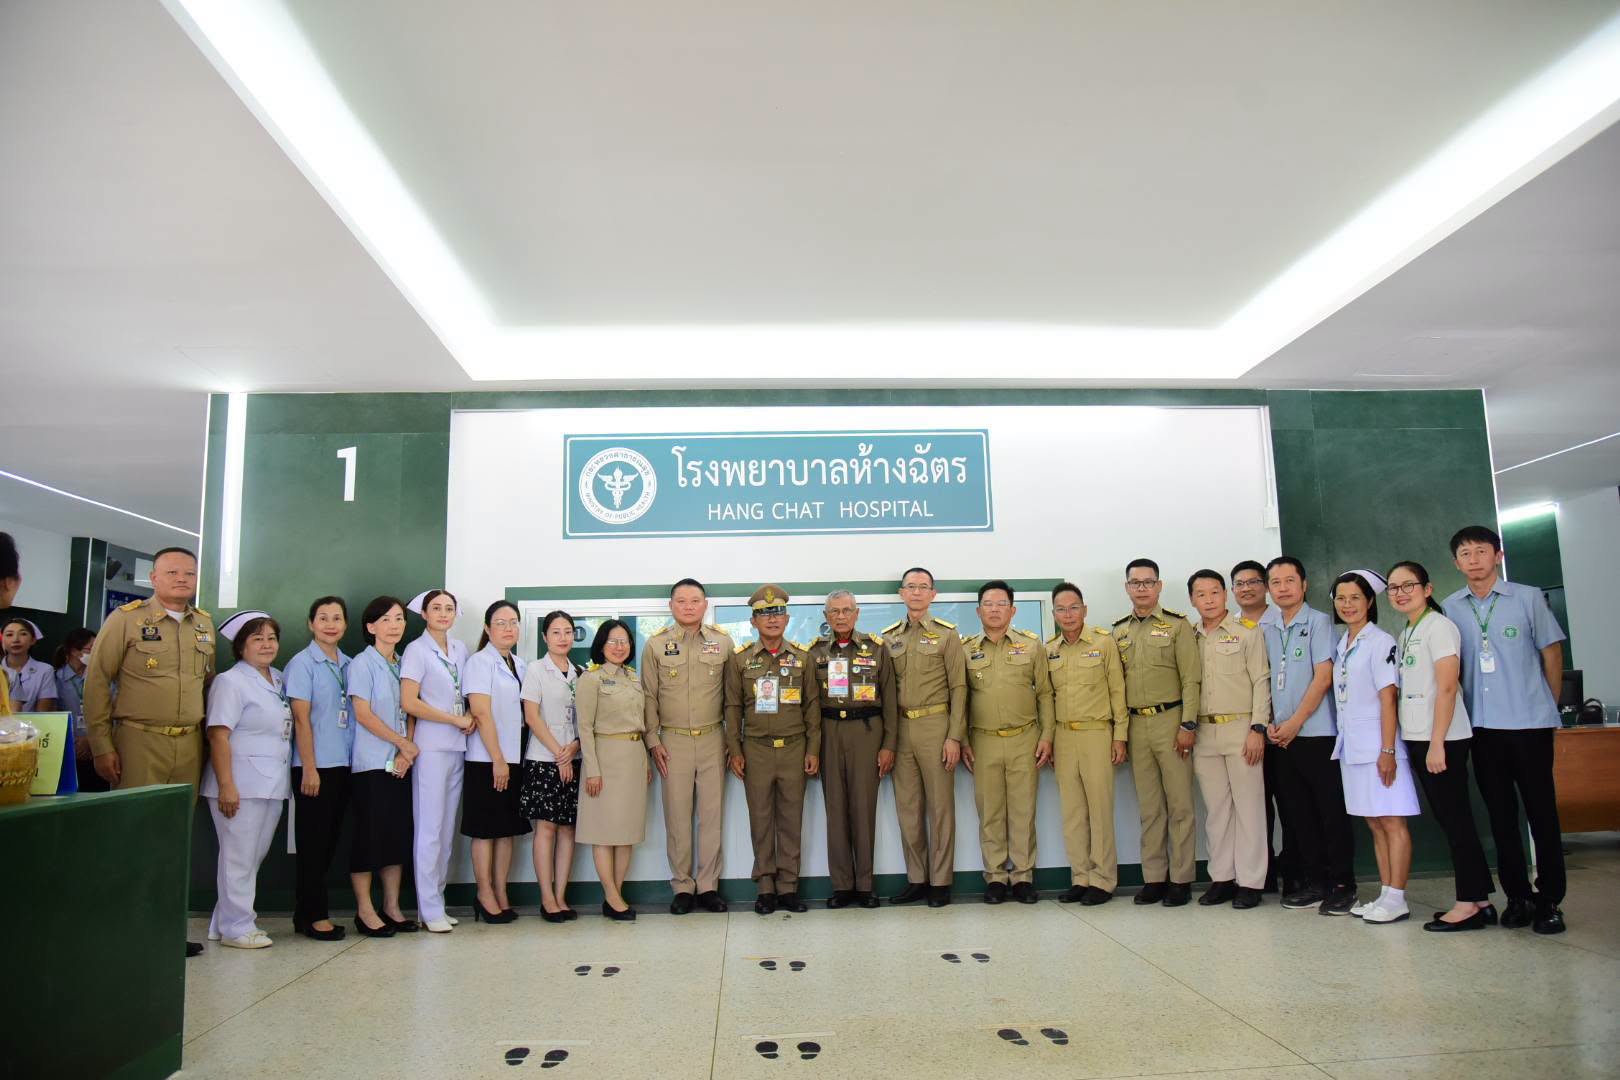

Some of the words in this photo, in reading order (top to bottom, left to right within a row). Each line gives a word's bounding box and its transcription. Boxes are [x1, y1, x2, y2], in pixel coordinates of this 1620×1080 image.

[337, 446, 357, 502] 1
[671, 442, 967, 487] โรงพยาบาลห้างฉัตร
[708, 502, 764, 521] HANG
[772, 501, 824, 520] CHAT
[840, 500, 933, 519] HOSPITAL
[824, 621, 831, 635] 2
